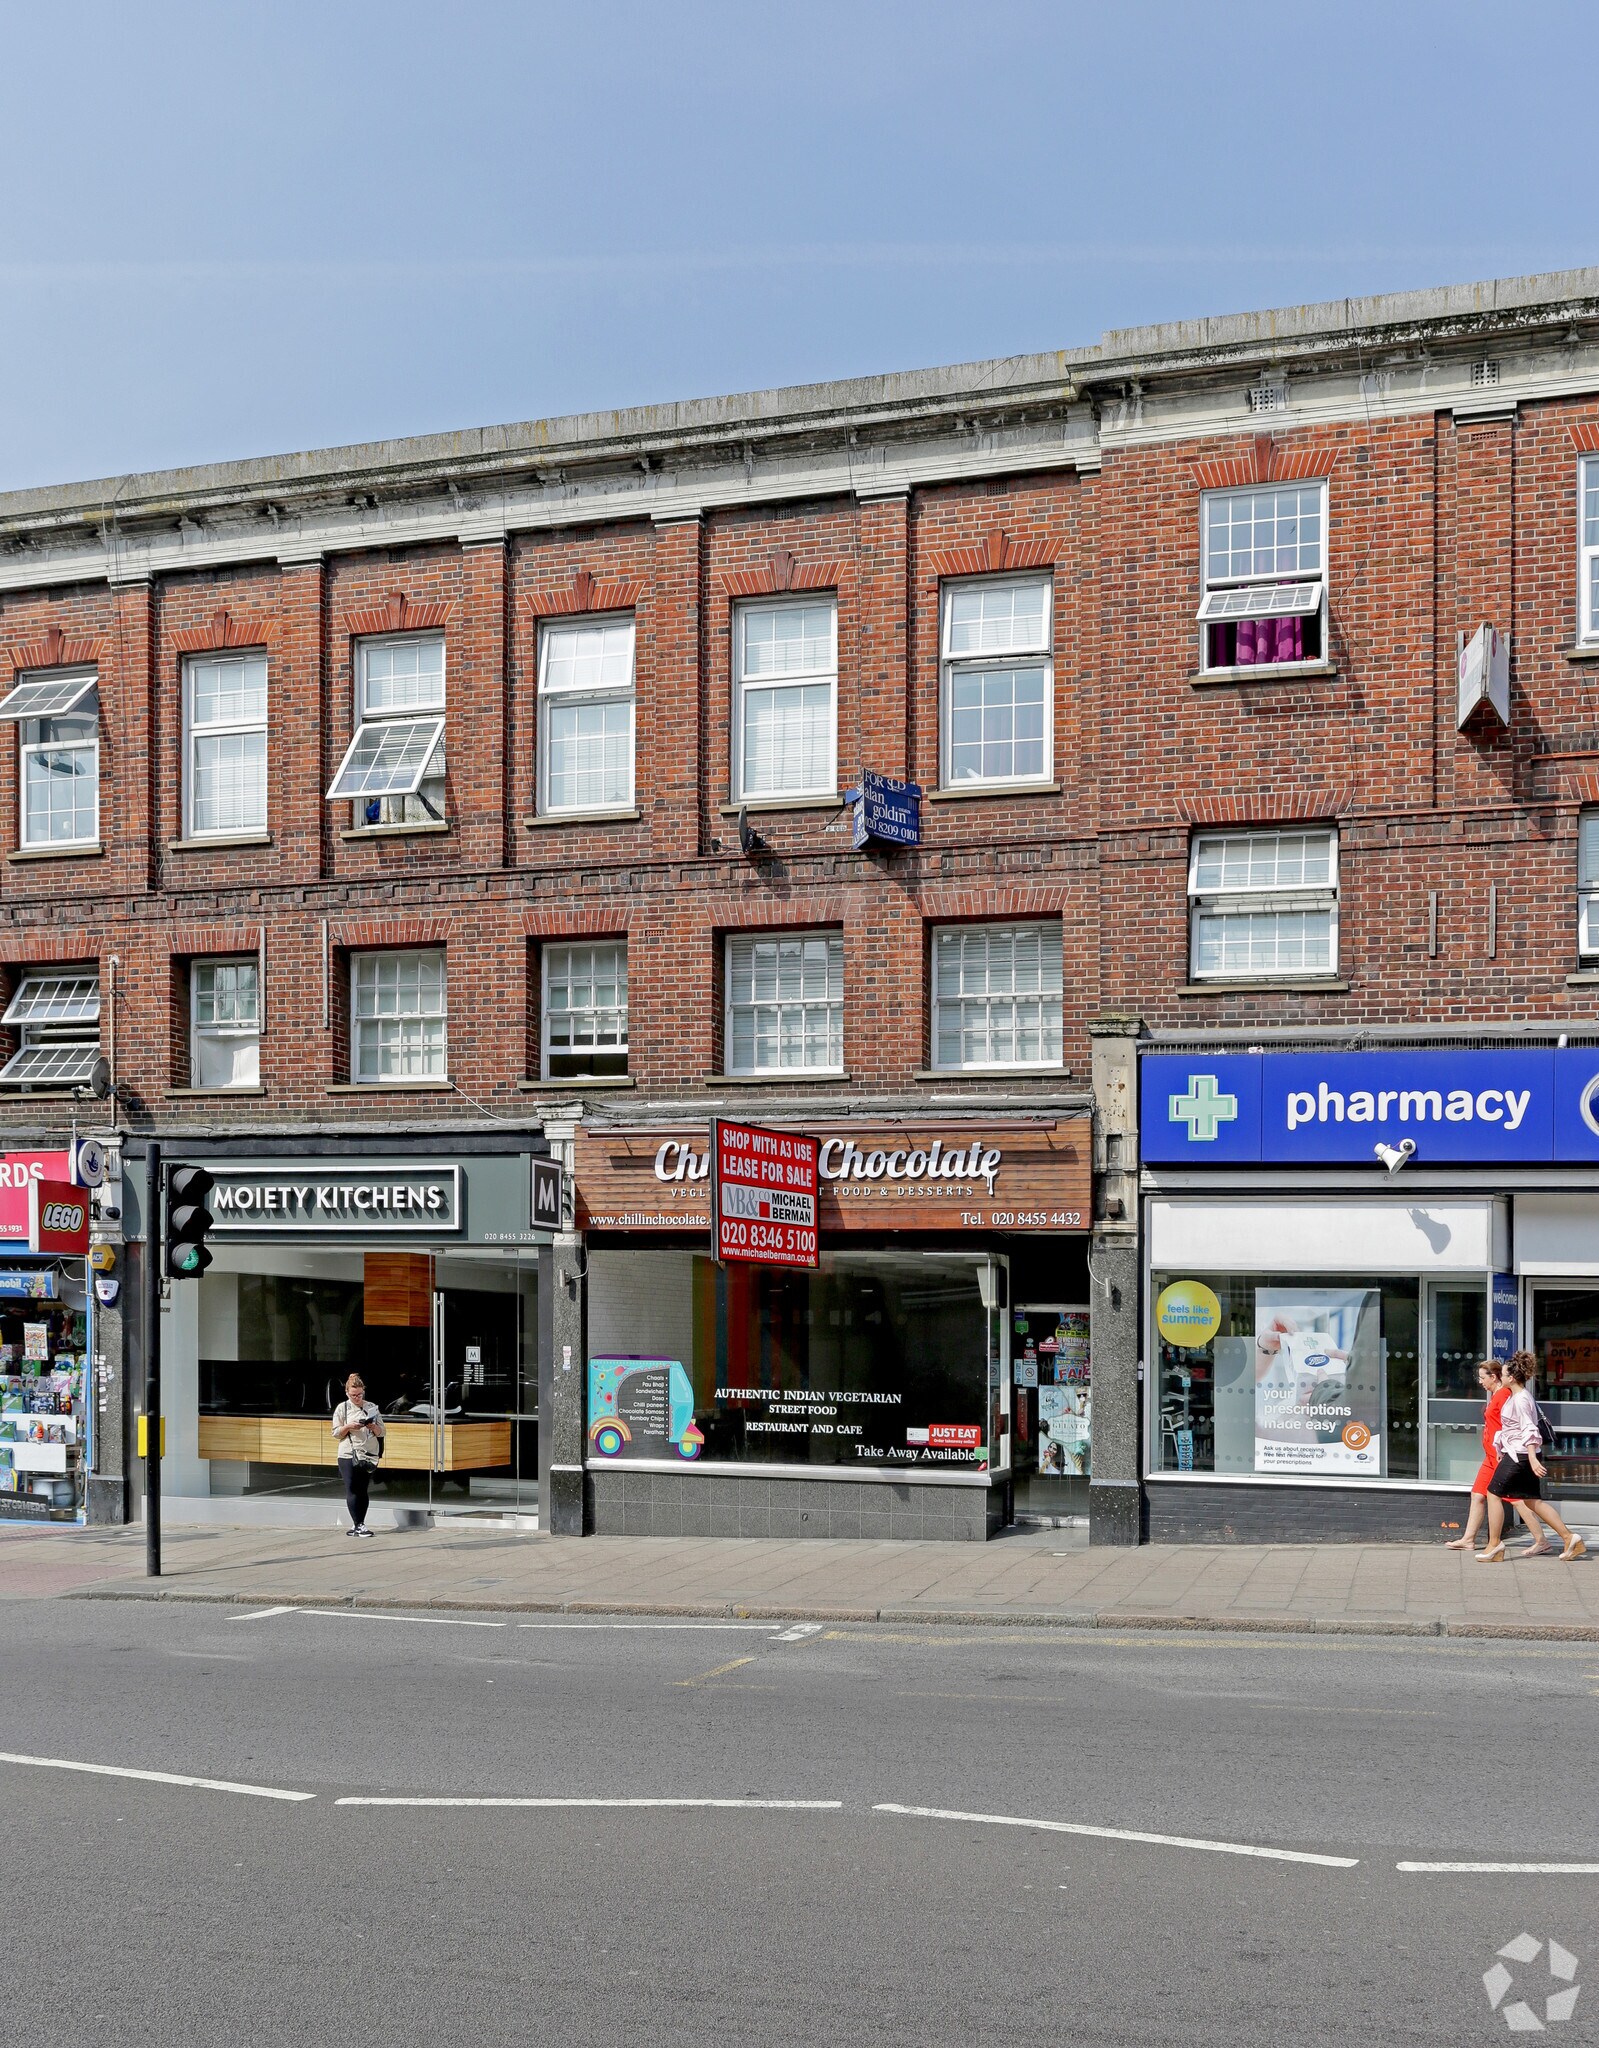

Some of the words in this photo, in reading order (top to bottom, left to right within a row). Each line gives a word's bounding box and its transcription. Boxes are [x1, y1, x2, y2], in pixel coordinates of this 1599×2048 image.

[865, 771, 884, 788] FOR
[865, 785, 885, 804] alan
[872, 805, 906, 824] goldin
[878, 822, 898, 835] 8209
[901, 828, 918, 841] 0101
[1287, 1082, 1531, 1130] pharmacy
[723, 1129, 749, 1150] SHOP
[752, 1135, 777, 1155] WITH
[780, 1140, 792, 1158] A3
[794, 1143, 812, 1162] USE
[818, 1138, 1001, 1186] Chocolate
[0, 1162, 44, 1187] RDS
[723, 1154, 758, 1179] LEASE
[762, 1161, 784, 1183] FOR
[787, 1165, 812, 1187] SALE
[213, 1186, 308, 1209] MOIETY
[316, 1185, 440, 1209] KITCHENS
[538, 1177, 555, 1212] M
[833, 1186, 871, 1196] FOOD
[880, 1187, 889, 1196] &
[898, 1186, 973, 1196] DESSERTS
[772, 1193, 811, 1209] MICHAEL
[43, 1204, 83, 1231] LEGO
[773, 1208, 810, 1223] BERMAN
[961, 1212, 985, 1225] Tel.
[992, 1213, 1014, 1225] 020
[1018, 1213, 1046, 1225] 8455
[1051, 1213, 1080, 1225] 4432
[722, 1222, 746, 1245] 020
[750, 1225, 783, 1247] 8346
[787, 1230, 815, 1252] 5100
[722, 1246, 815, 1263] www.michaelberman.co.uk
[1493, 1289, 1517, 1305] welcome
[1168, 1304, 1190, 1314] feels
[1193, 1306, 1209, 1314] like
[1162, 1316, 1214, 1325] summer
[1494, 1318, 1515, 1333] pharmacy
[1494, 1336, 1508, 1350] beauty
[1552, 1346, 1577, 1359] only
[714, 1388, 780, 1400] AUTHENTIC
[784, 1390, 825, 1401] INDIAN
[829, 1392, 901, 1404] VEGETARIAN
[1264, 1390, 1293, 1400] your
[769, 1405, 807, 1414] STREET
[808, 1406, 837, 1415] FOOD
[1264, 1404, 1351, 1417] prescriptions
[746, 1422, 808, 1432] RESTAURANT
[811, 1424, 833, 1433] AND
[837, 1425, 862, 1435] CAFE
[931, 1428, 956, 1438] JUST
[958, 1429, 977, 1438] EAT
[1264, 1420, 1301, 1429] made
[1306, 1421, 1336, 1433] easy
[855, 1445, 884, 1456] Take
[887, 1447, 919, 1461] Away
[921, 1448, 976, 1460] Available
